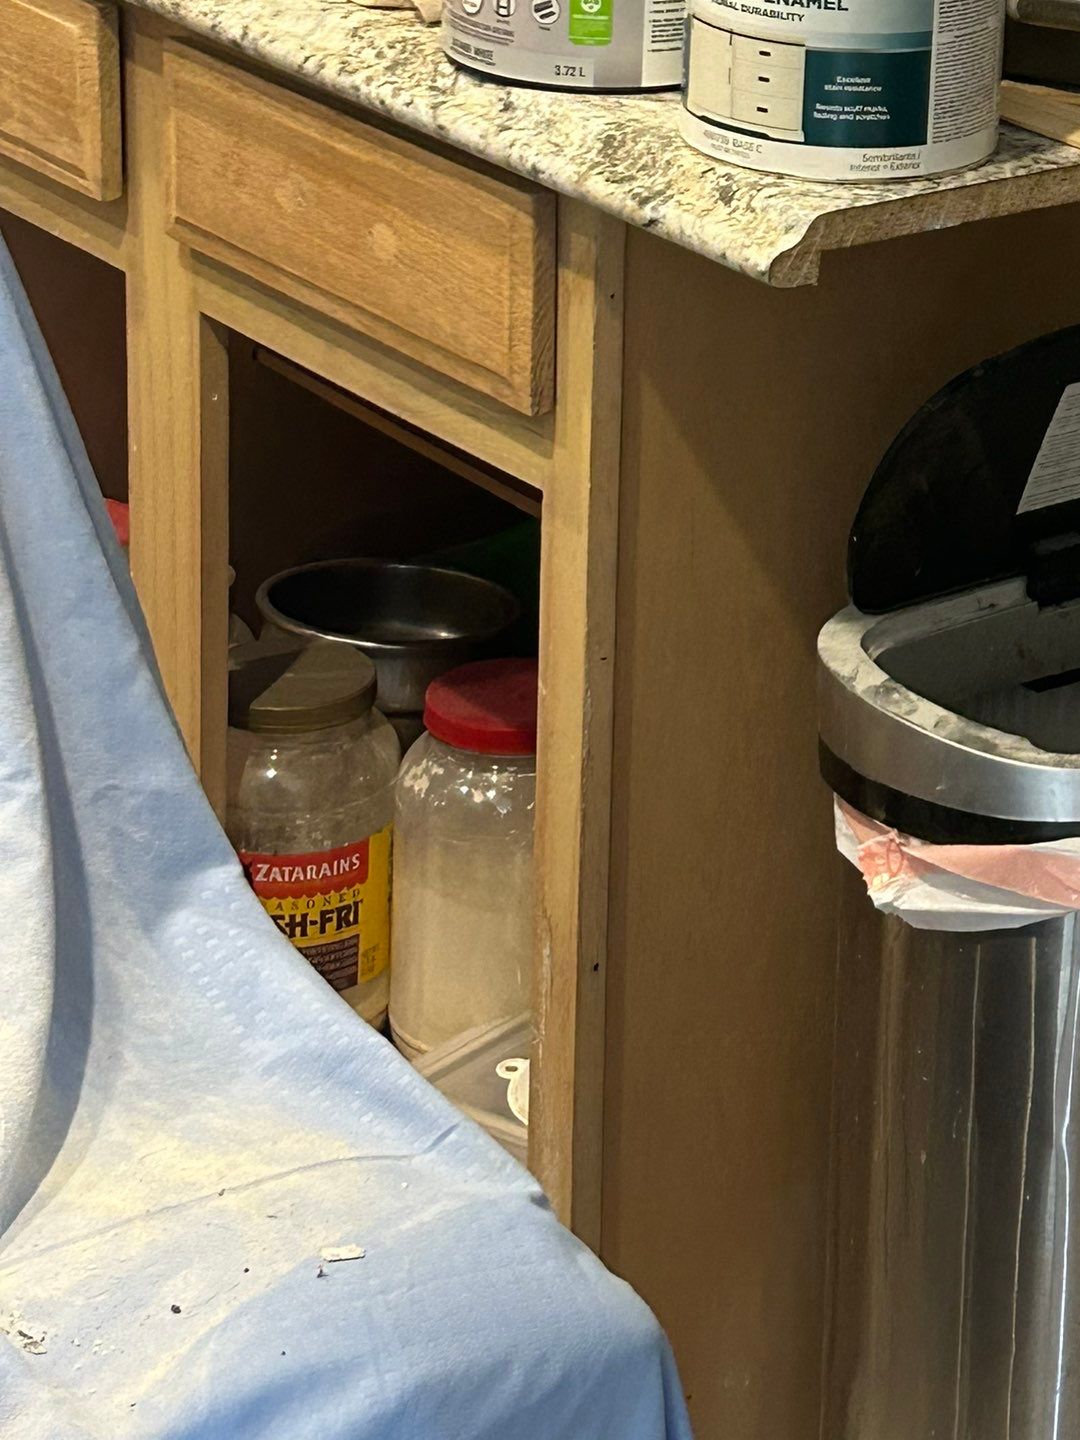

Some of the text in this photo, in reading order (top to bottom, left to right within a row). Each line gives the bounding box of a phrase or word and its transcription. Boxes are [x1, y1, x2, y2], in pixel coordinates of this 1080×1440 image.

[740, 4, 805, 22] DURABILITY
[264, 889, 360, 912] ASONED
[270, 898, 364, 939] SH-FRI
